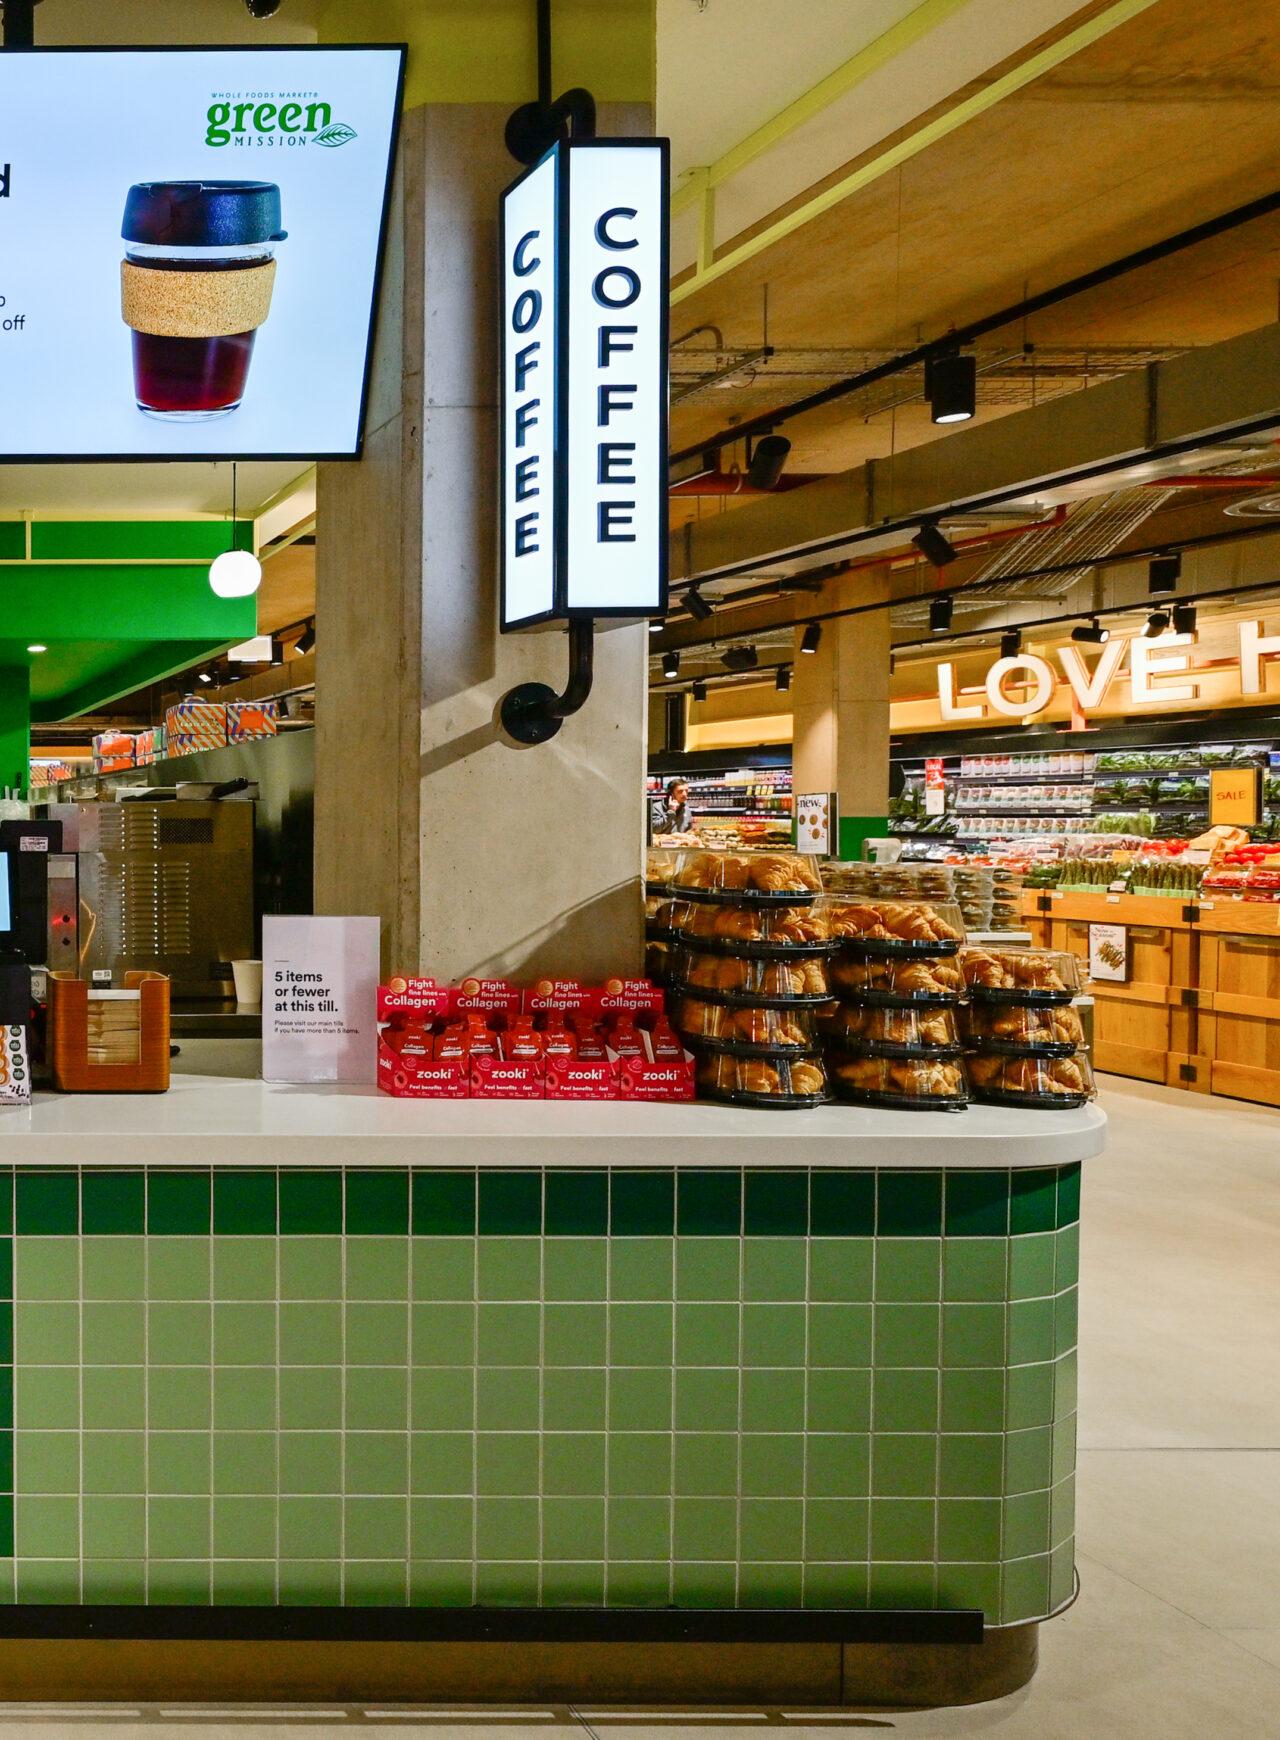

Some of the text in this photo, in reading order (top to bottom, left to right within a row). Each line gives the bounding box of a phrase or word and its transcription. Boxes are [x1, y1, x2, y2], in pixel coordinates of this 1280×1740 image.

[205, 101, 331, 147] green
[234, 136, 307, 147] MISSION
[3, 315, 25, 330] off
[592, 206, 641, 543] COFFEE
[511, 230, 542, 558] COFFEE
[937, 631, 1200, 721] LOVE
[1216, 790, 1247, 801] SALE
[800, 799, 819, 808] new
[275, 971, 322, 982] 5 items
[408, 979, 433, 990] Fight
[481, 981, 506, 991] Fight
[555, 982, 578, 991] Fight
[625, 981, 649, 991] Fight
[292, 985, 330, 997] fewer
[275, 1000, 338, 1011] at this till.
[384, 995, 436, 1008] Collagen
[457, 998, 508, 1010] Collagen
[531, 998, 580, 1010] Collagen
[600, 997, 651, 1009] Collagen
[417, 1068, 452, 1079] zooki
[491, 1068, 526, 1079] zooki
[568, 1069, 603, 1080] zooki
[643, 1070, 677, 1081] zooki
